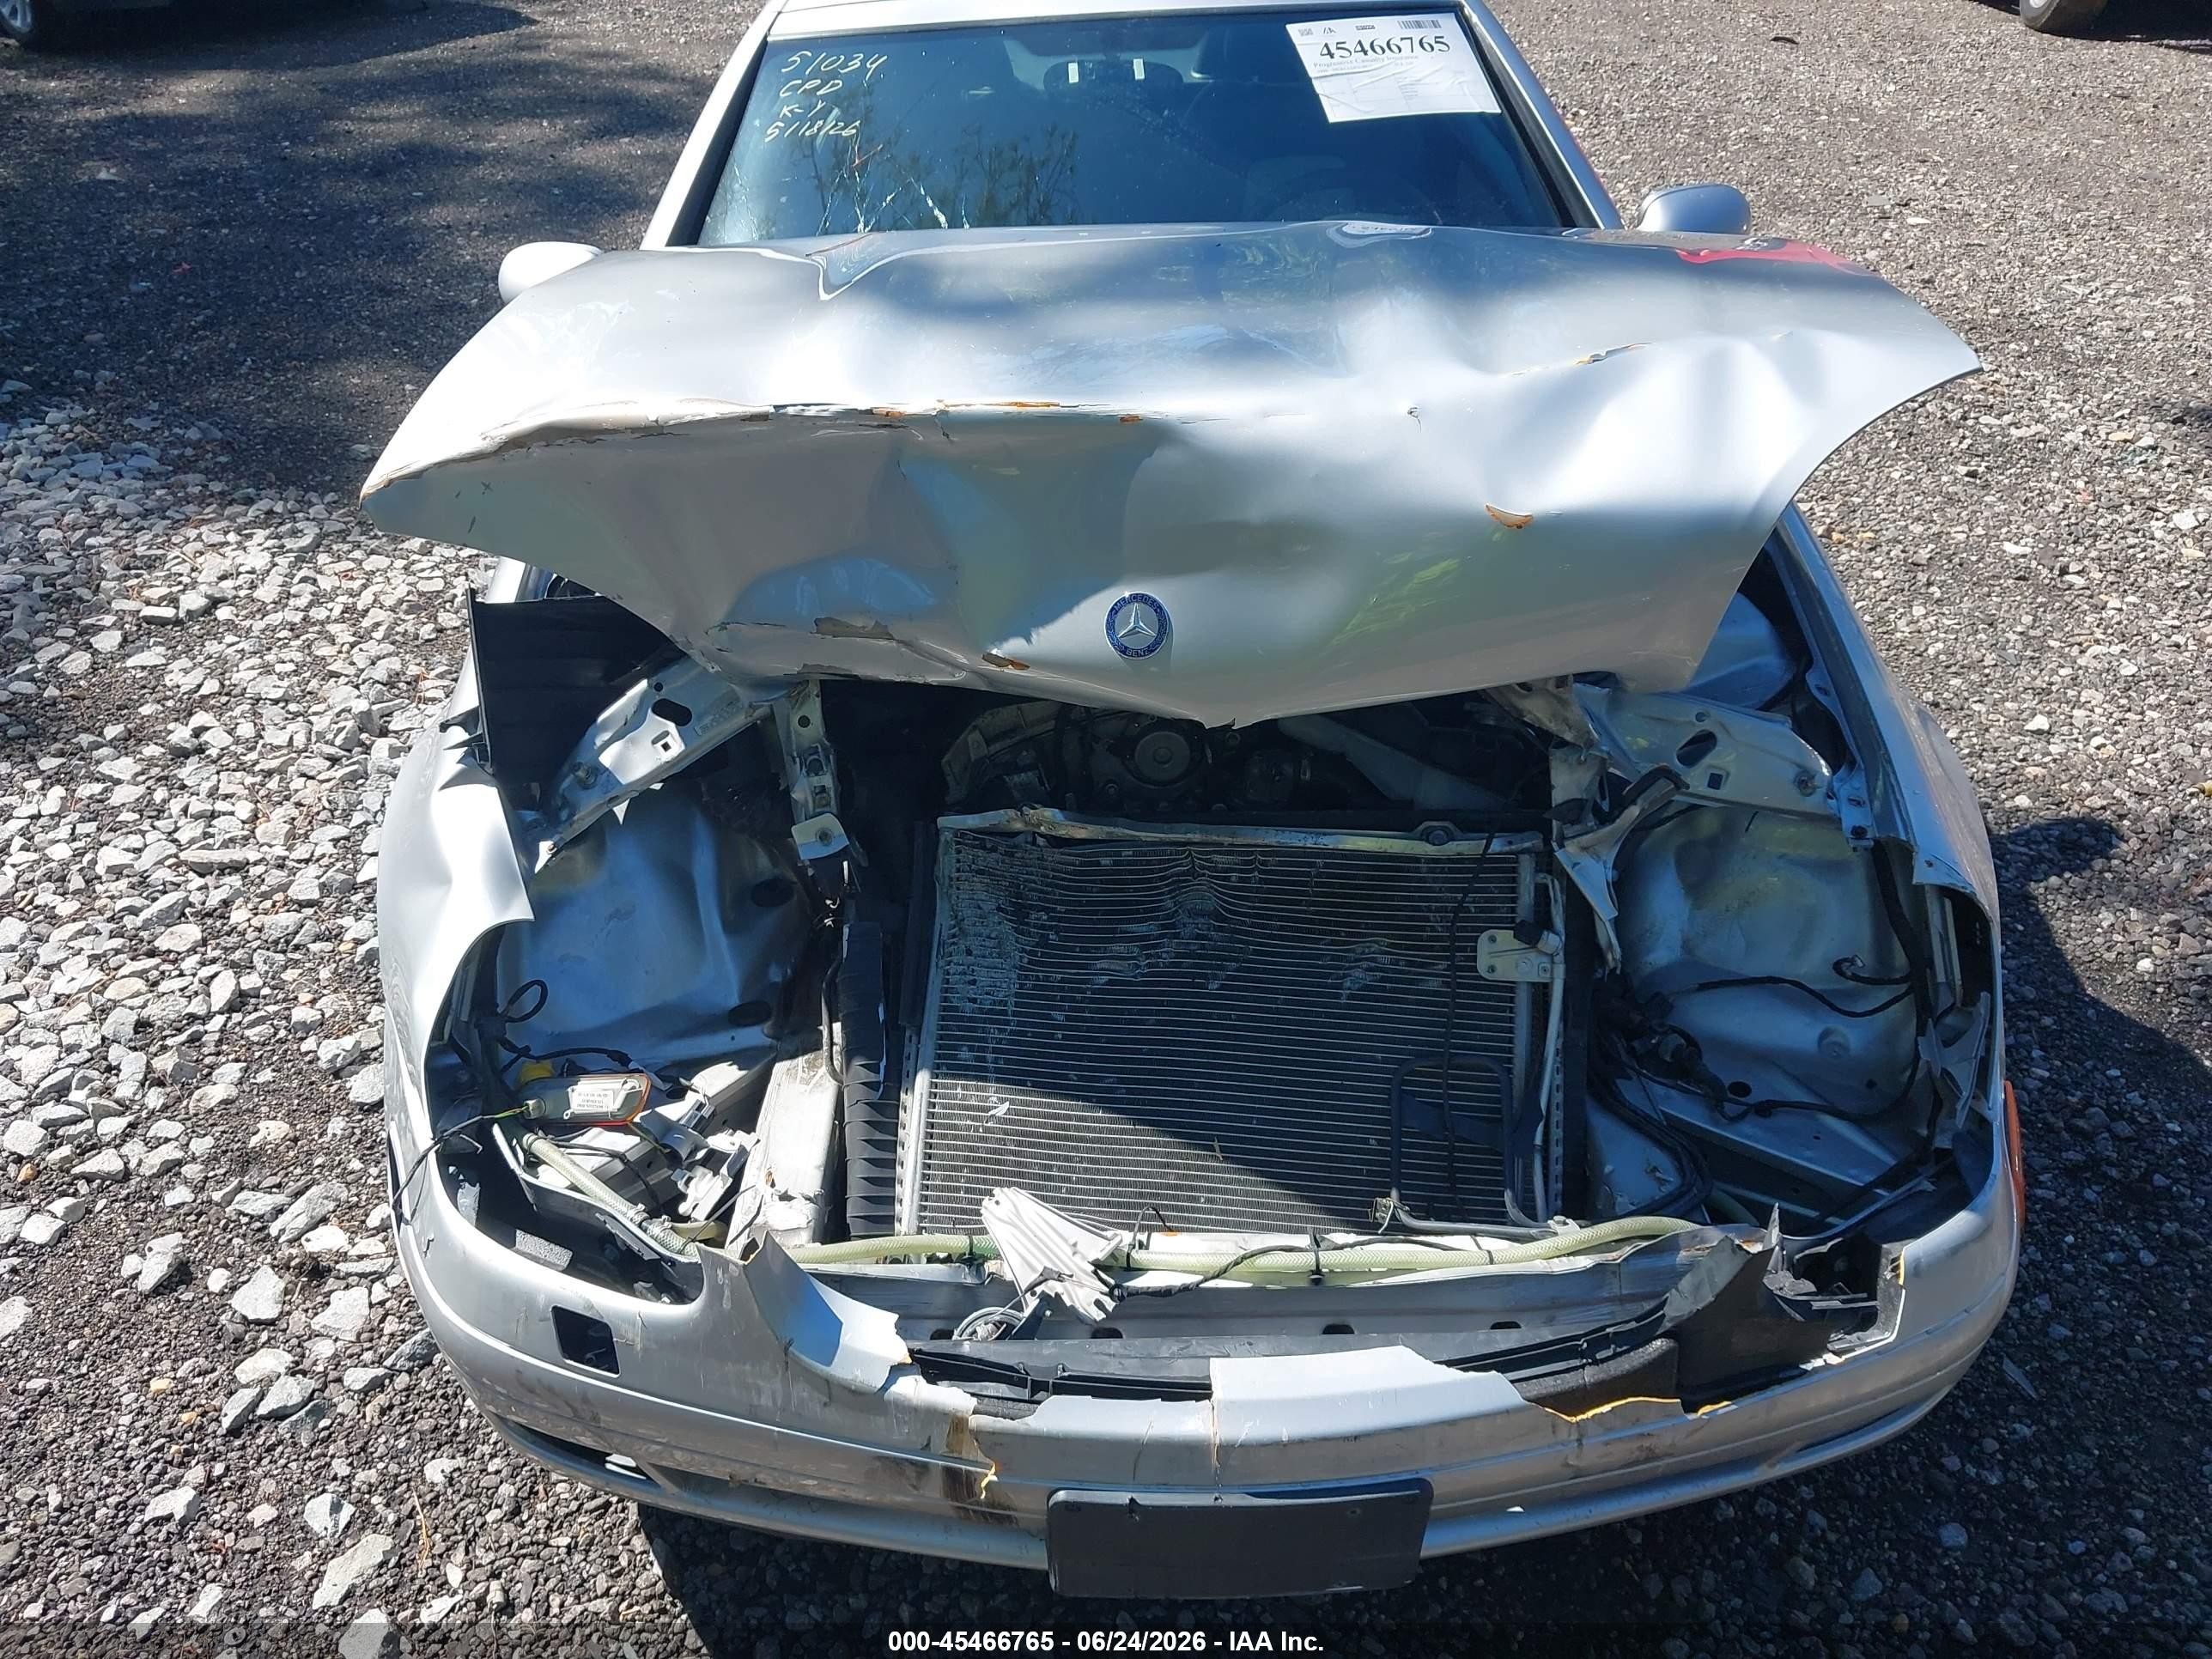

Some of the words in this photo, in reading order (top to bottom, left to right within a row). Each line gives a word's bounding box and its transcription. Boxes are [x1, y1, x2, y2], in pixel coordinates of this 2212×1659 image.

[1320, 35, 1451, 59] 45466765
[781, 50, 888, 82] 51034
[1114, 594, 1160, 611] MERCEDES
[1126, 647, 1151, 658] BENZ
